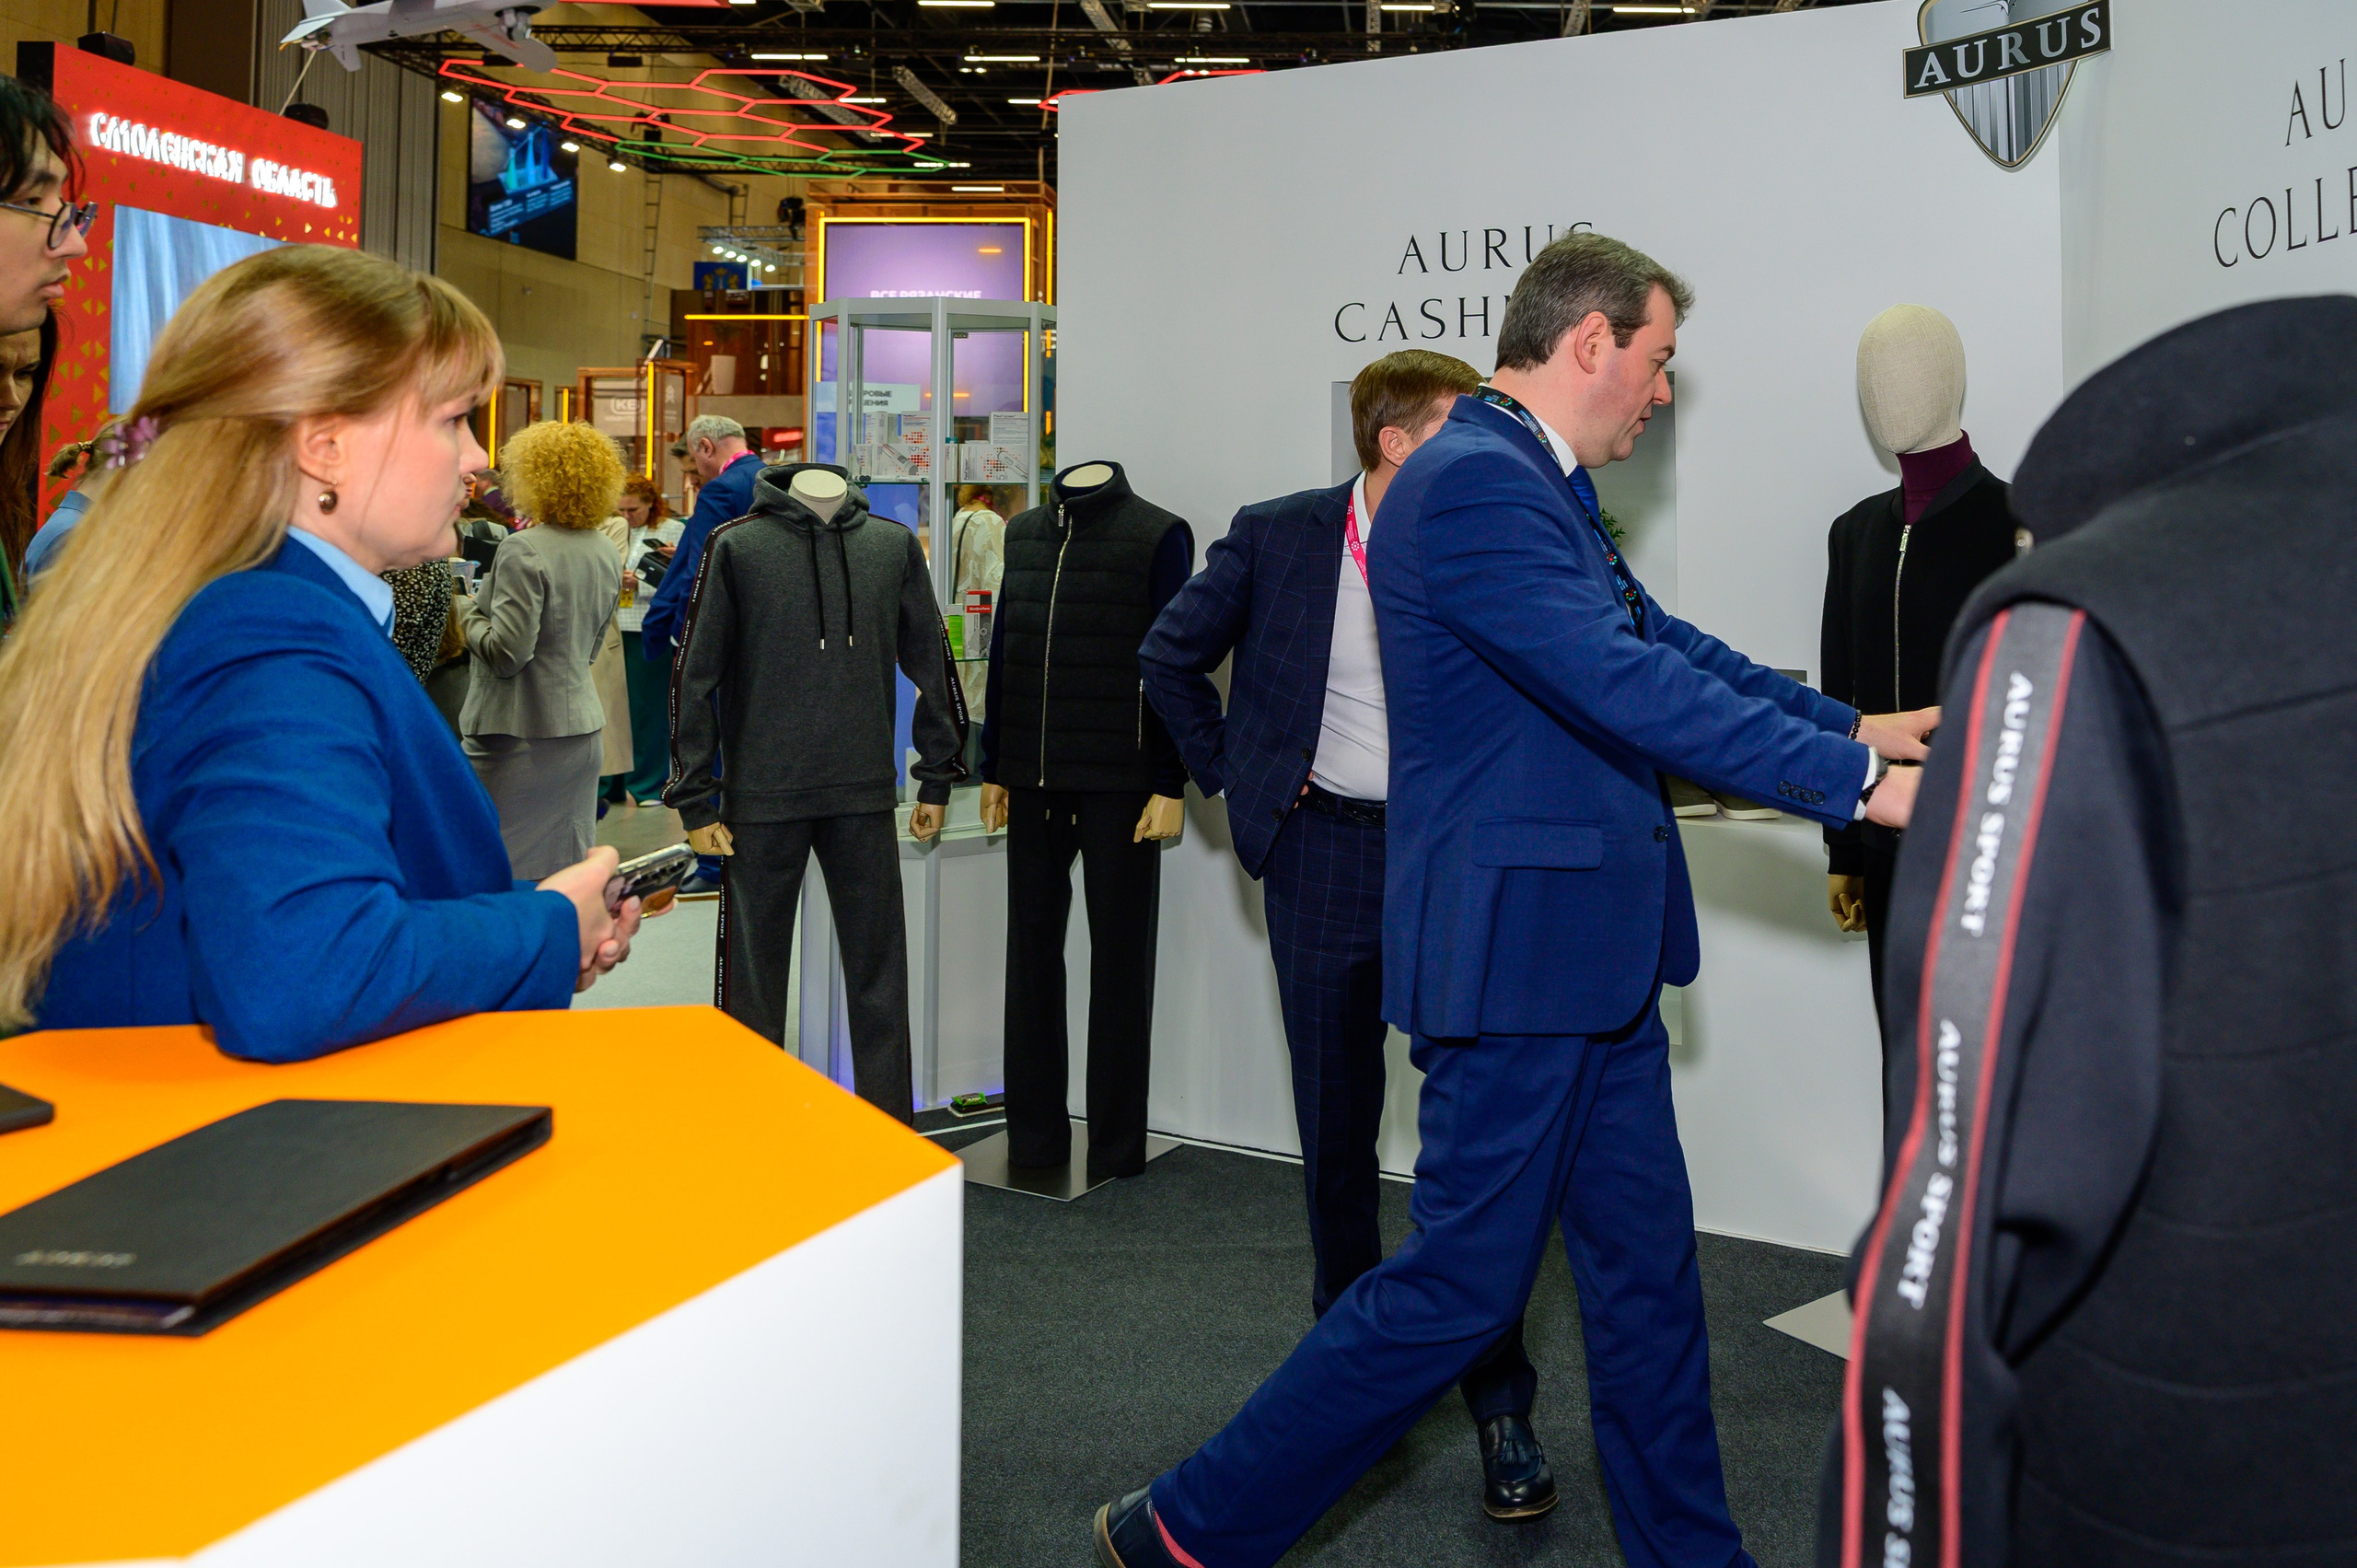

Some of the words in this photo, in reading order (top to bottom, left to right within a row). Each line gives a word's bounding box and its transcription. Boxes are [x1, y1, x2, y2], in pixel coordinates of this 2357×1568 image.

[1914, 7, 2100, 88] AURUS
[2285, 58, 2346, 147] AU
[90, 112, 245, 183] СМОЛЕНСКАЯ
[251, 158, 337, 208] ОБЛАСТЬ
[1397, 222, 1593, 274] AURU
[1334, 295, 1509, 343] CASH
[950, 677, 959, 702] AURUS
[957, 703, 965, 725] SPORT
[1988, 670, 2033, 806] AURUS
[1960, 812, 2004, 936] SPORT
[1937, 1018, 1961, 1167] AURUS
[1897, 1171, 1953, 1309] SPORT
